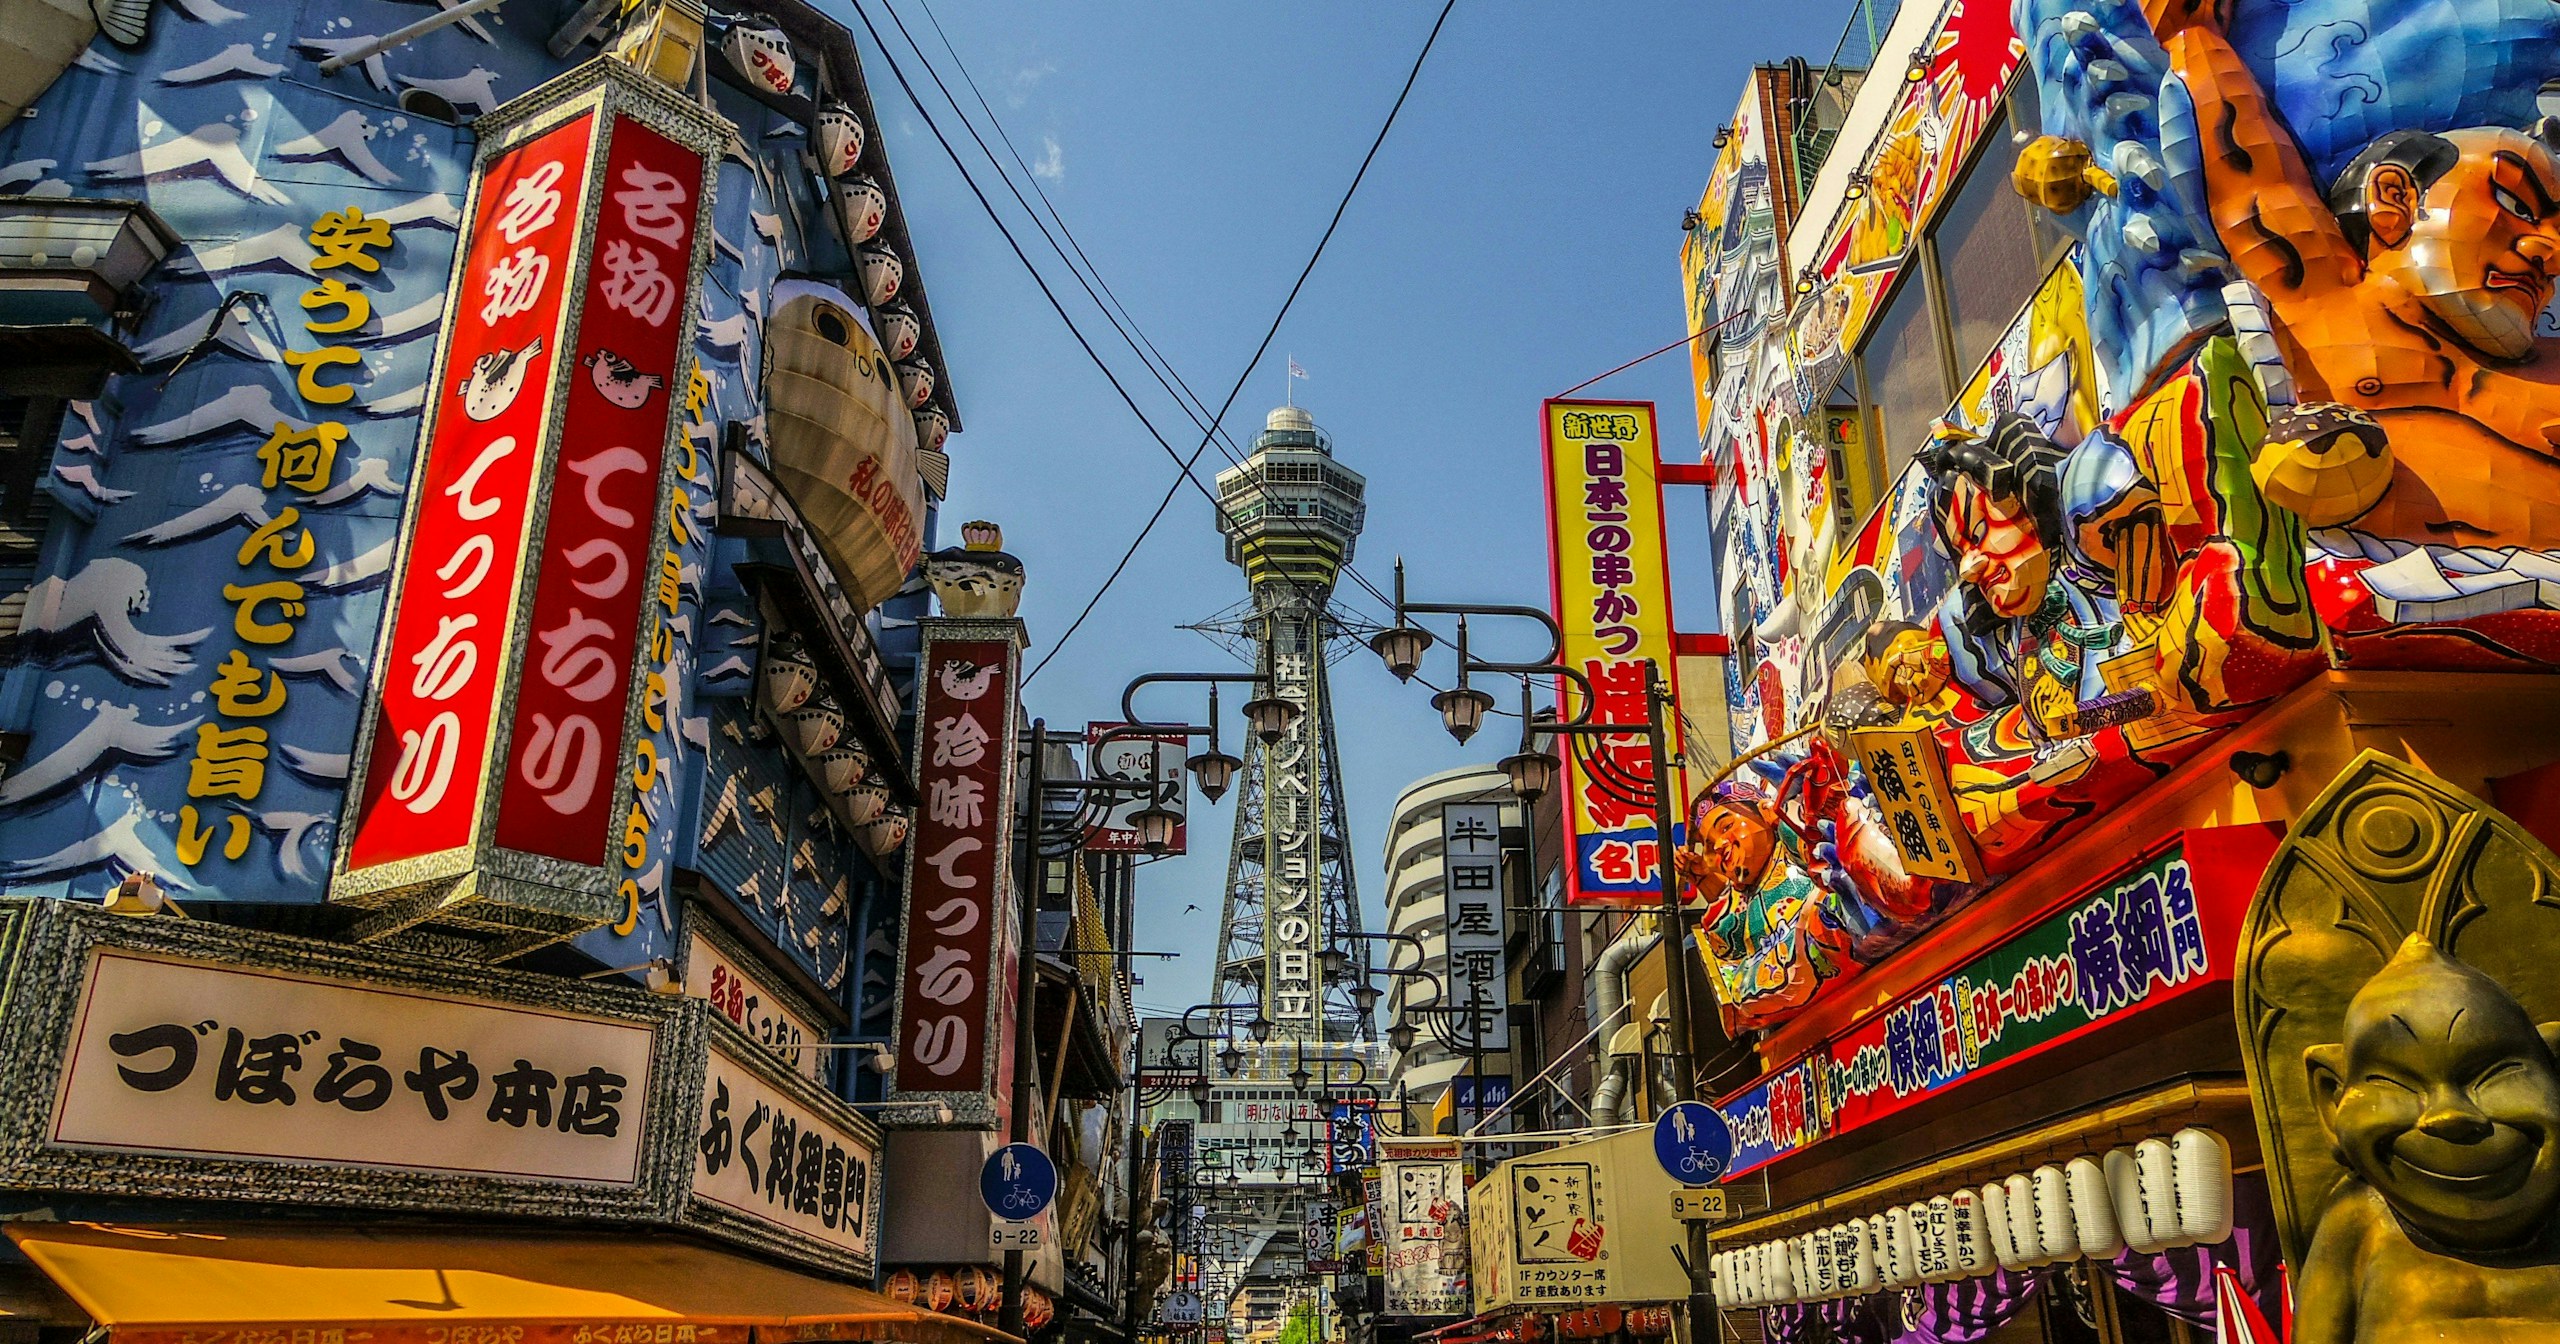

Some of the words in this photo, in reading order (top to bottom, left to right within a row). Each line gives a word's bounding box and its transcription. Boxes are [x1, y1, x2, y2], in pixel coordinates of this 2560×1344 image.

[481, 161, 564, 331] 名物
[600, 160, 686, 328] 名物
[1563, 414, 1638, 440] 新世界
[176, 206, 393, 866] 安うて何んでも旨い
[1585, 443, 1639, 656] 日本一の串かつ
[392, 436, 516, 814] てっちり
[521, 446, 649, 814] てっちり
[1868, 748, 1934, 863] 横綱
[914, 712, 989, 1075] 珍味てっちり
[1449, 816, 1504, 1034] 半田屋酒店
[710, 963, 801, 1067] 名物てっちり
[1956, 977, 1980, 1069] 新世界
[1972, 955, 2076, 1047] 日本一の串かつ
[2070, 875, 2174, 1016] 横綱
[2165, 865, 2206, 978] 名門
[108, 1019, 628, 1139] づぼらや本店
[1886, 995, 1945, 1098] 横綱
[1939, 986, 1962, 1076] 名門
[700, 1075, 865, 1239] ふぐ料理専門
[1674, 1196, 1723, 1213] 9-22
[993, 1229, 1039, 1245] 9-22
[1520, 1269, 1531, 1281] 1F
[1535, 1269, 1606, 1281] カウンター席
[1520, 1285, 1532, 1297] 2F
[1535, 1285, 1607, 1297] 座敷あります
[1816, 1244, 1832, 1292] ホルモン
[1914, 1220, 1934, 1274] サーモン
[1930, 1212, 1948, 1271] 紅しょうが
[1954, 1208, 1976, 1267] 海幸串かつ
[1389, 1297, 1463, 1311] 宴会予約受付中
